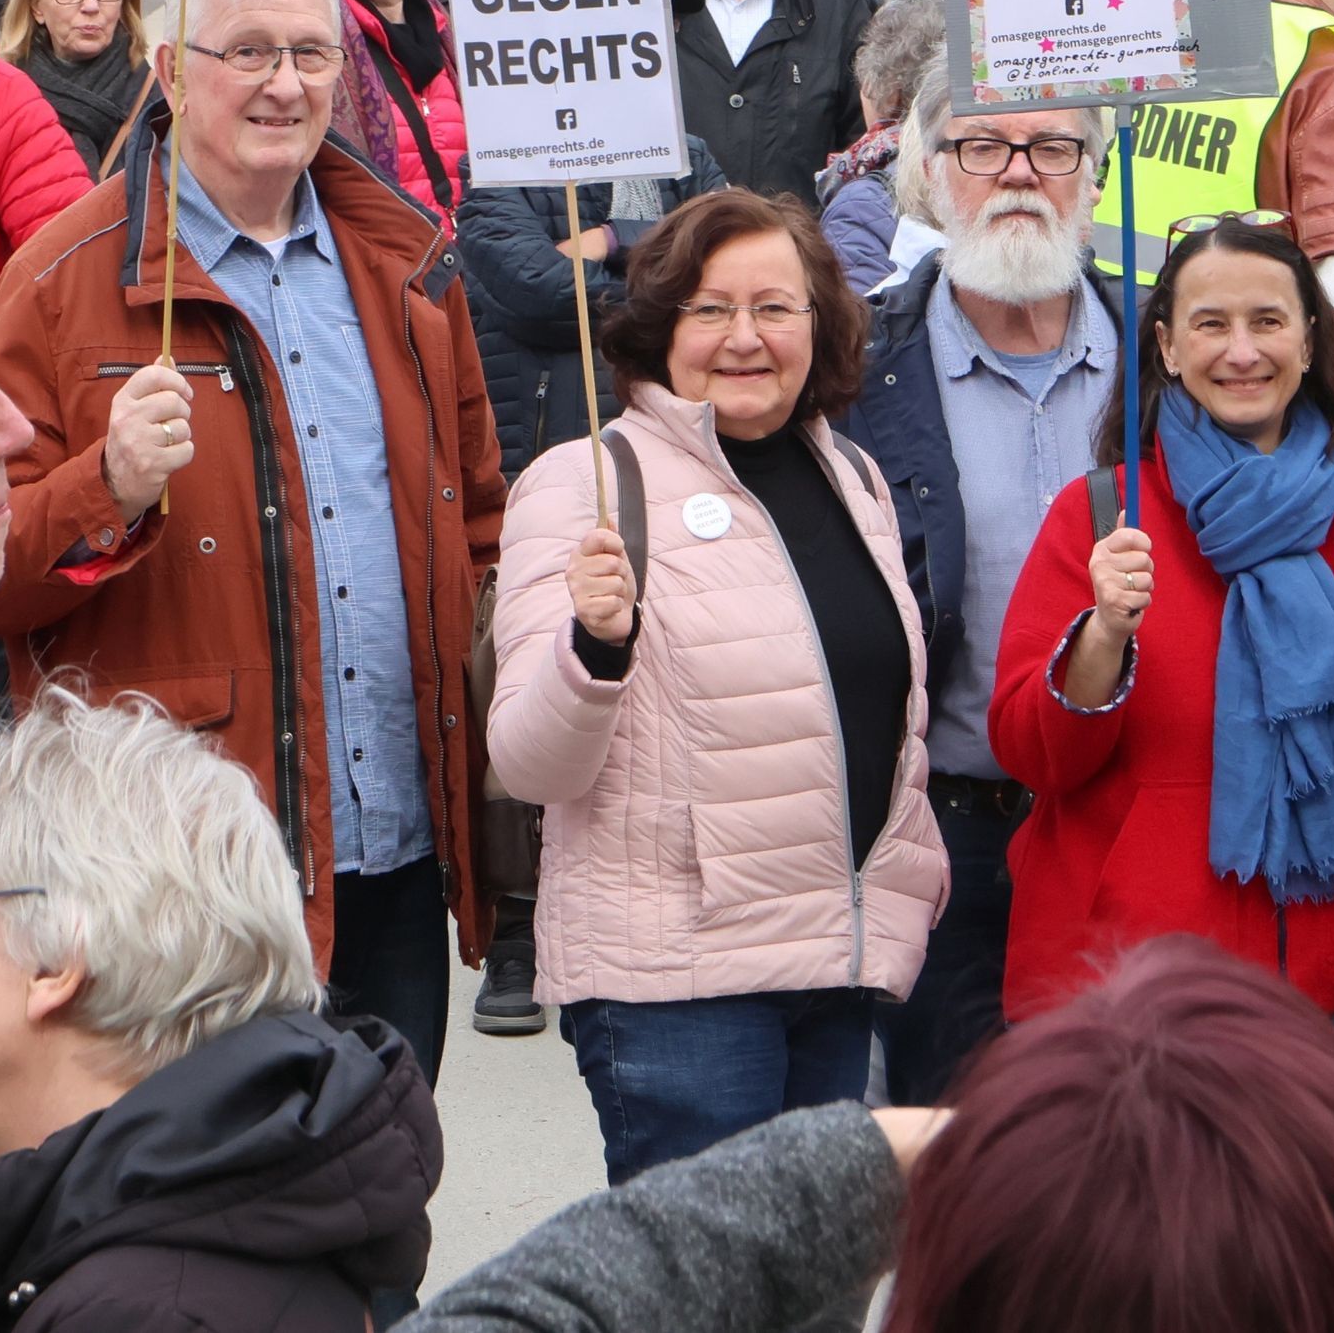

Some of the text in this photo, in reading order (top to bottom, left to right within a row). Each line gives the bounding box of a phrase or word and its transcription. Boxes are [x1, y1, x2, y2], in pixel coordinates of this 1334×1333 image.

[991, 22, 1106, 44] omasgegenrechts.de
[1056, 29, 1162, 50] #omasgegenrechts
[464, 32, 661, 86] RECHTS
[993, 39, 1201, 68] omasgegenrechts-gummersbach
[476, 137, 605, 160] omasgegenrechts.de
[548, 146, 671, 169] #omasgegenrechts
